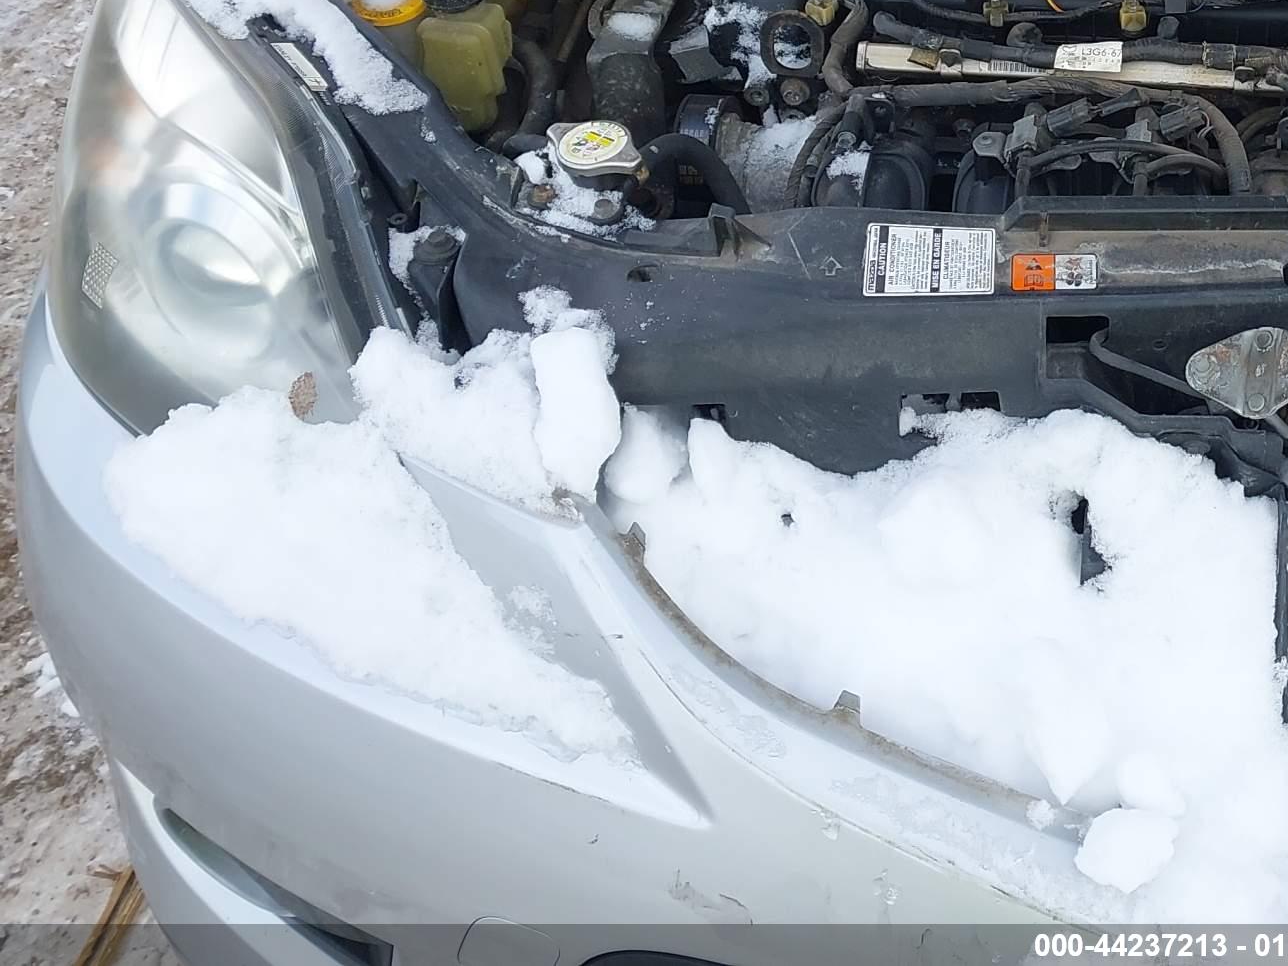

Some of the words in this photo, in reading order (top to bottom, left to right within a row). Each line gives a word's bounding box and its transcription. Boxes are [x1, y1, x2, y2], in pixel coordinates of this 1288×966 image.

[878, 242, 887, 276] CAUTION
[888, 233, 898, 273] CONDITIONER
[933, 232, 942, 258] GARDE
[867, 259, 876, 291] mazda
[931, 270, 940, 288] MISE
